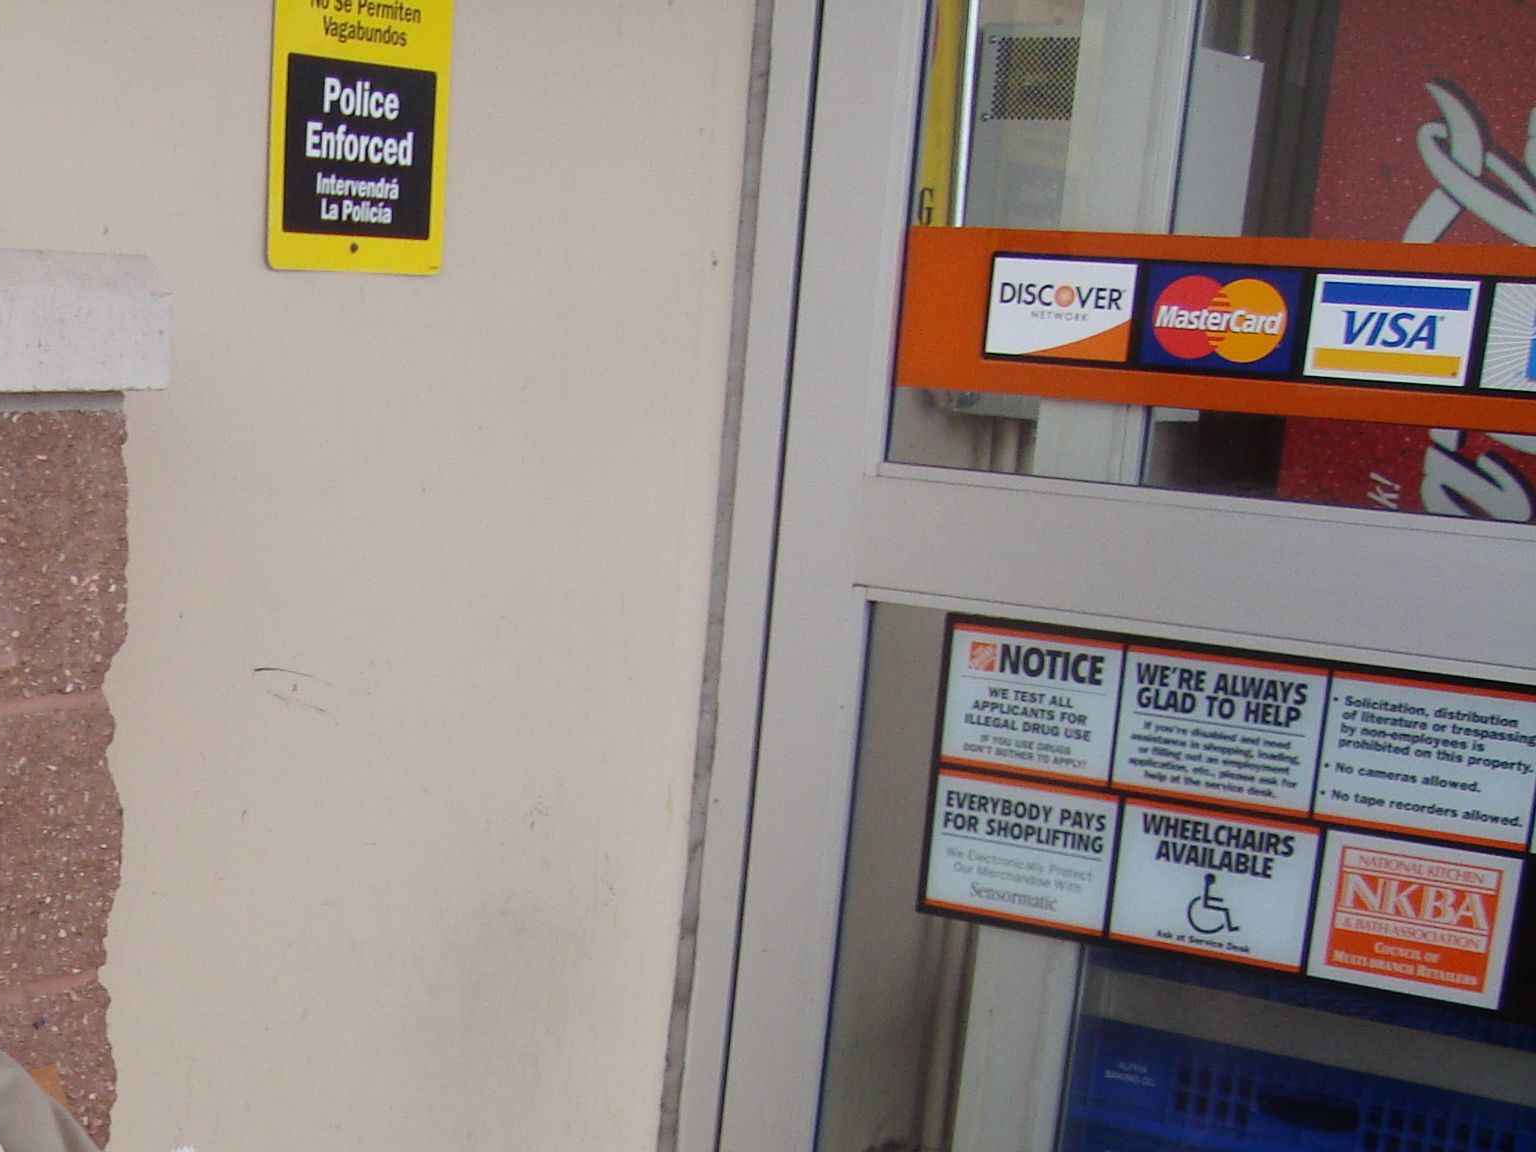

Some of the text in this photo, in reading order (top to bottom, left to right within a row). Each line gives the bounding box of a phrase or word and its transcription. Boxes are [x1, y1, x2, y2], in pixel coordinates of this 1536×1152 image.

[357, 0, 421, 24] Permiten
[323, 15, 407, 47] Vagabundos
[323, 77, 400, 120] Police
[305, 121, 415, 166] Enforced
[316, 171, 400, 200] Intervendrá
[320, 198, 392, 224] La Policía
[1000, 282, 1123, 311] DISCOVER
[1031, 311, 1089, 322] NETWORK
[1154, 305, 1283, 335] MasterCard
[1342, 310, 1438, 350] VISA
[999, 643, 1105, 686] NOTICE
[989, 687, 1073, 709] WE TEST ALL
[1137, 662, 1309, 706] WE'RE ALWAYS
[972, 699, 1088, 725] APPLICANTS FOR
[1137, 687, 1302, 728] GLAD TO HELP
[1434, 707, 1519, 728] distribution
[964, 713, 1092, 742] ILLEGAL DRUG USE
[992, 736, 1011, 747] YOU
[1015, 740, 1033, 750] USE
[1240, 735, 1260, 746] and
[1340, 722, 1485, 752] by non-employees is
[1342, 710, 1536, 748] of literature or trespassing
[1036, 753, 1050, 764] TO
[1338, 737, 1534, 776] prohibited on this property.
[1334, 762, 1482, 793] No cameras allowed.
[946, 790, 1107, 832] EVERYBODY PAYS
[1330, 789, 1523, 828] No tape recorders allowed.
[943, 812, 1104, 854] FOR SHOPLIFTING
[1142, 812, 1295, 858] WHEELCHAIRS
[1155, 840, 1275, 879] AVAILABLE
[1360, 855, 1484, 884] NATIONAL KITCHEN
[970, 882, 1059, 912] Sensormatic
[1339, 873, 1489, 930] NKBA
[1355, 918, 1389, 932] BATH
[1393, 924, 1480, 949] ASSOCIATION
